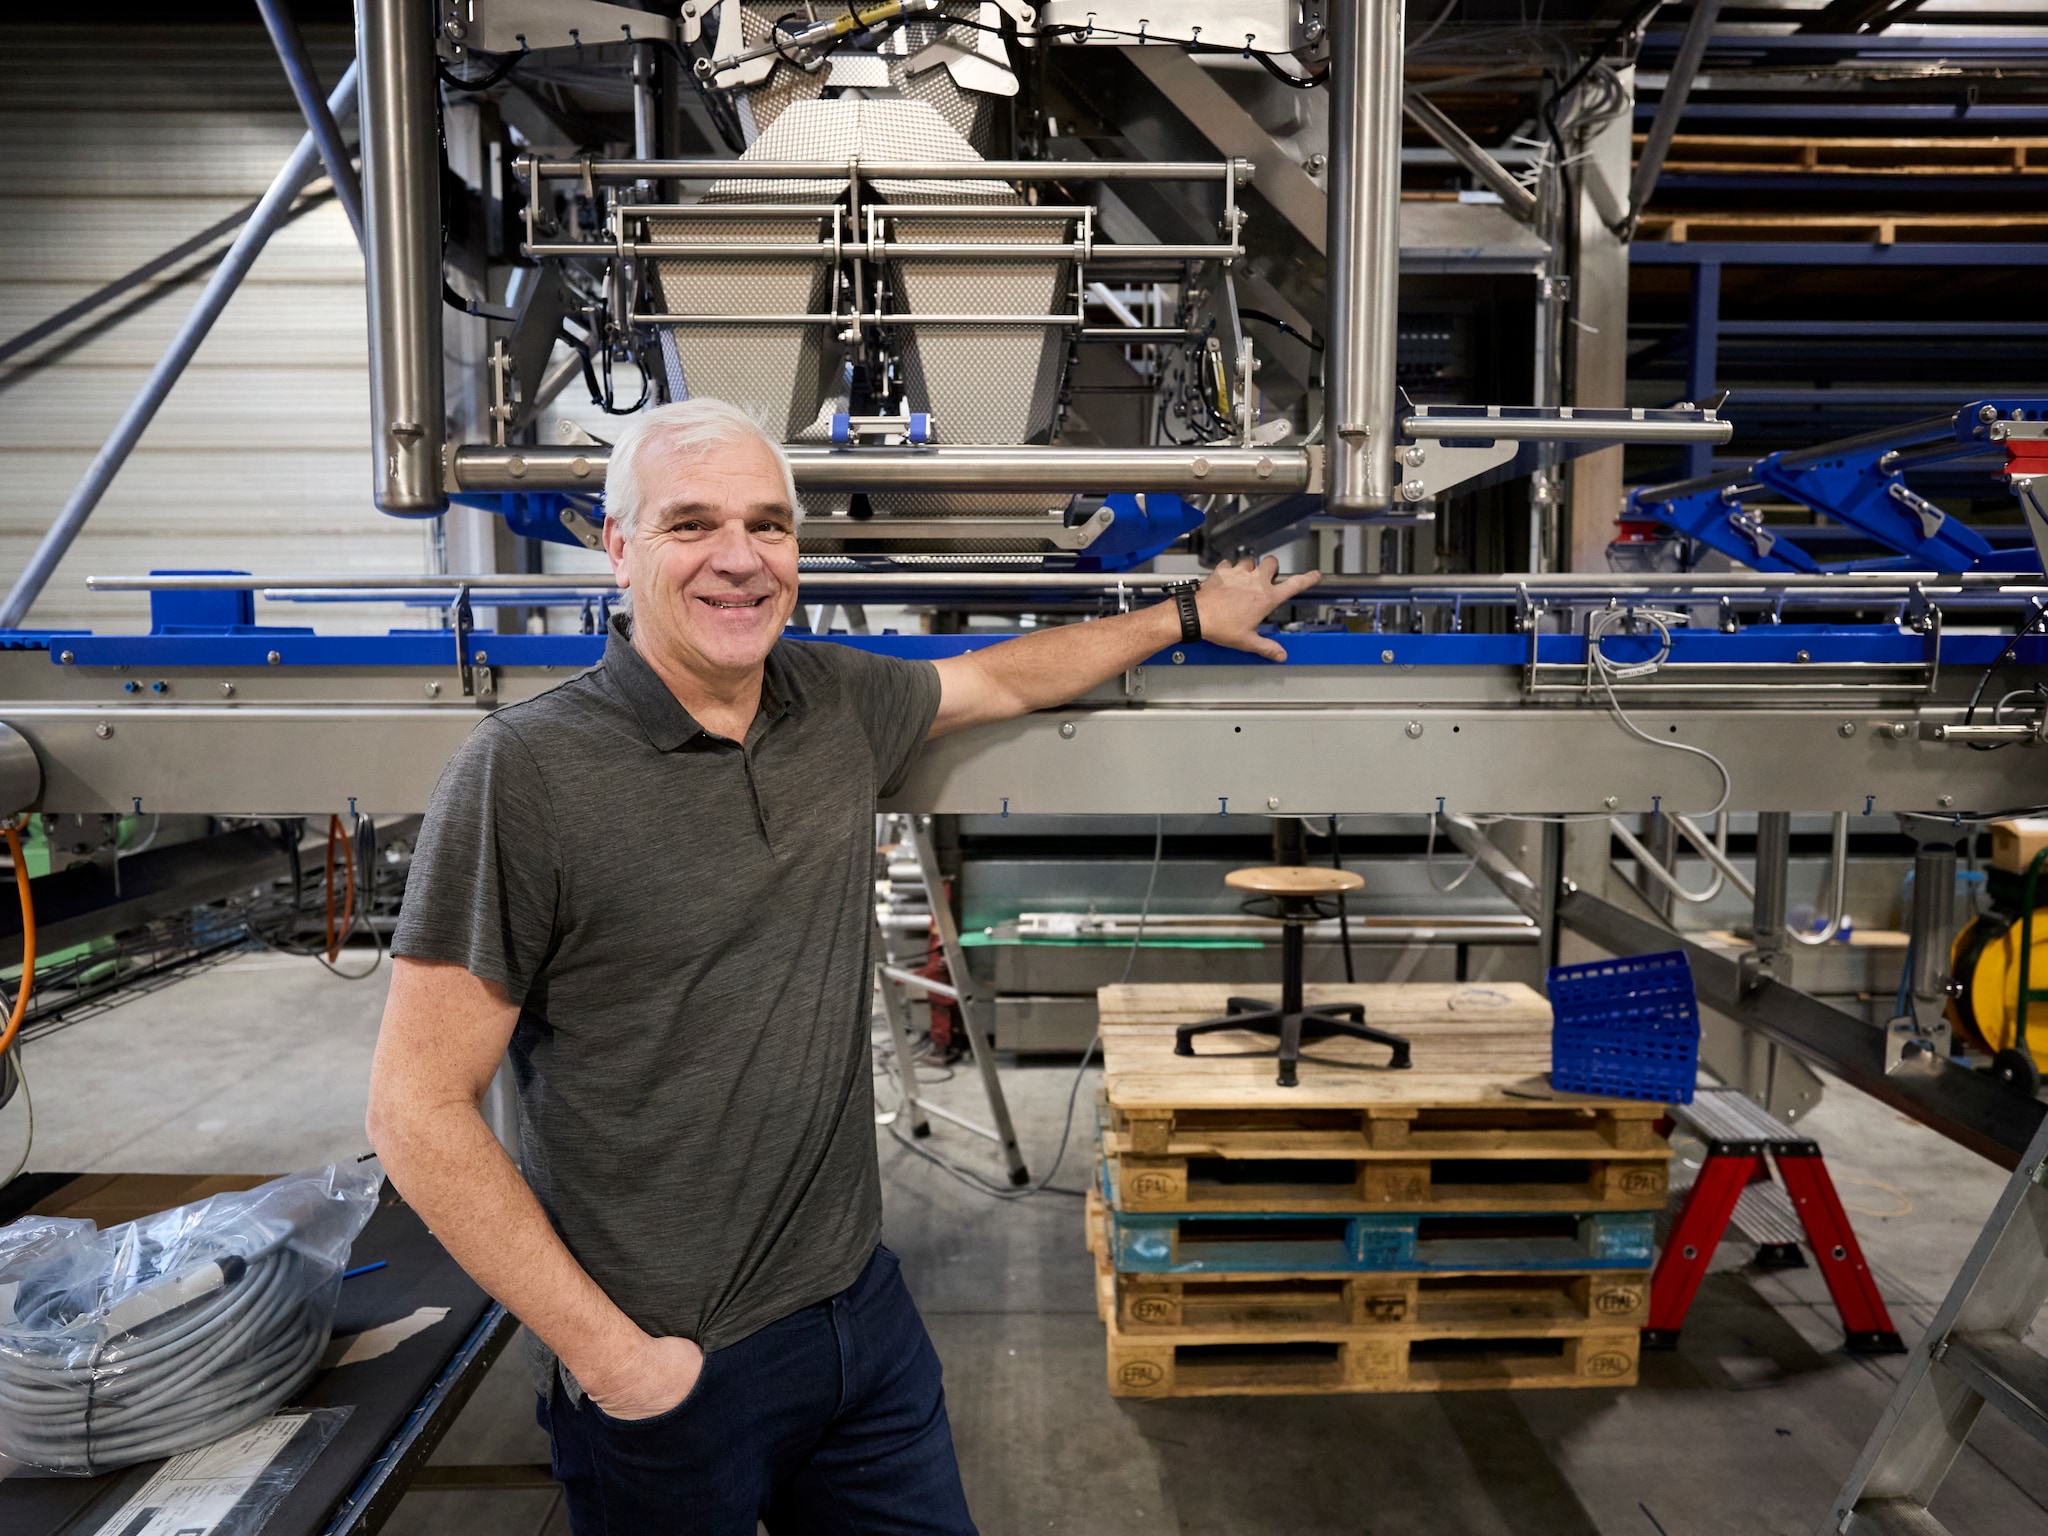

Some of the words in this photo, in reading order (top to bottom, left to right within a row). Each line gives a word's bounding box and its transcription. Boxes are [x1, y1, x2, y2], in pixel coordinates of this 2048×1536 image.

[1137, 1179, 1171, 1194] EPAL
[1603, 1295, 1634, 1311] EPAL
[1592, 1357, 1624, 1373] EPAL
[1124, 1366, 1158, 1383] EPAL
